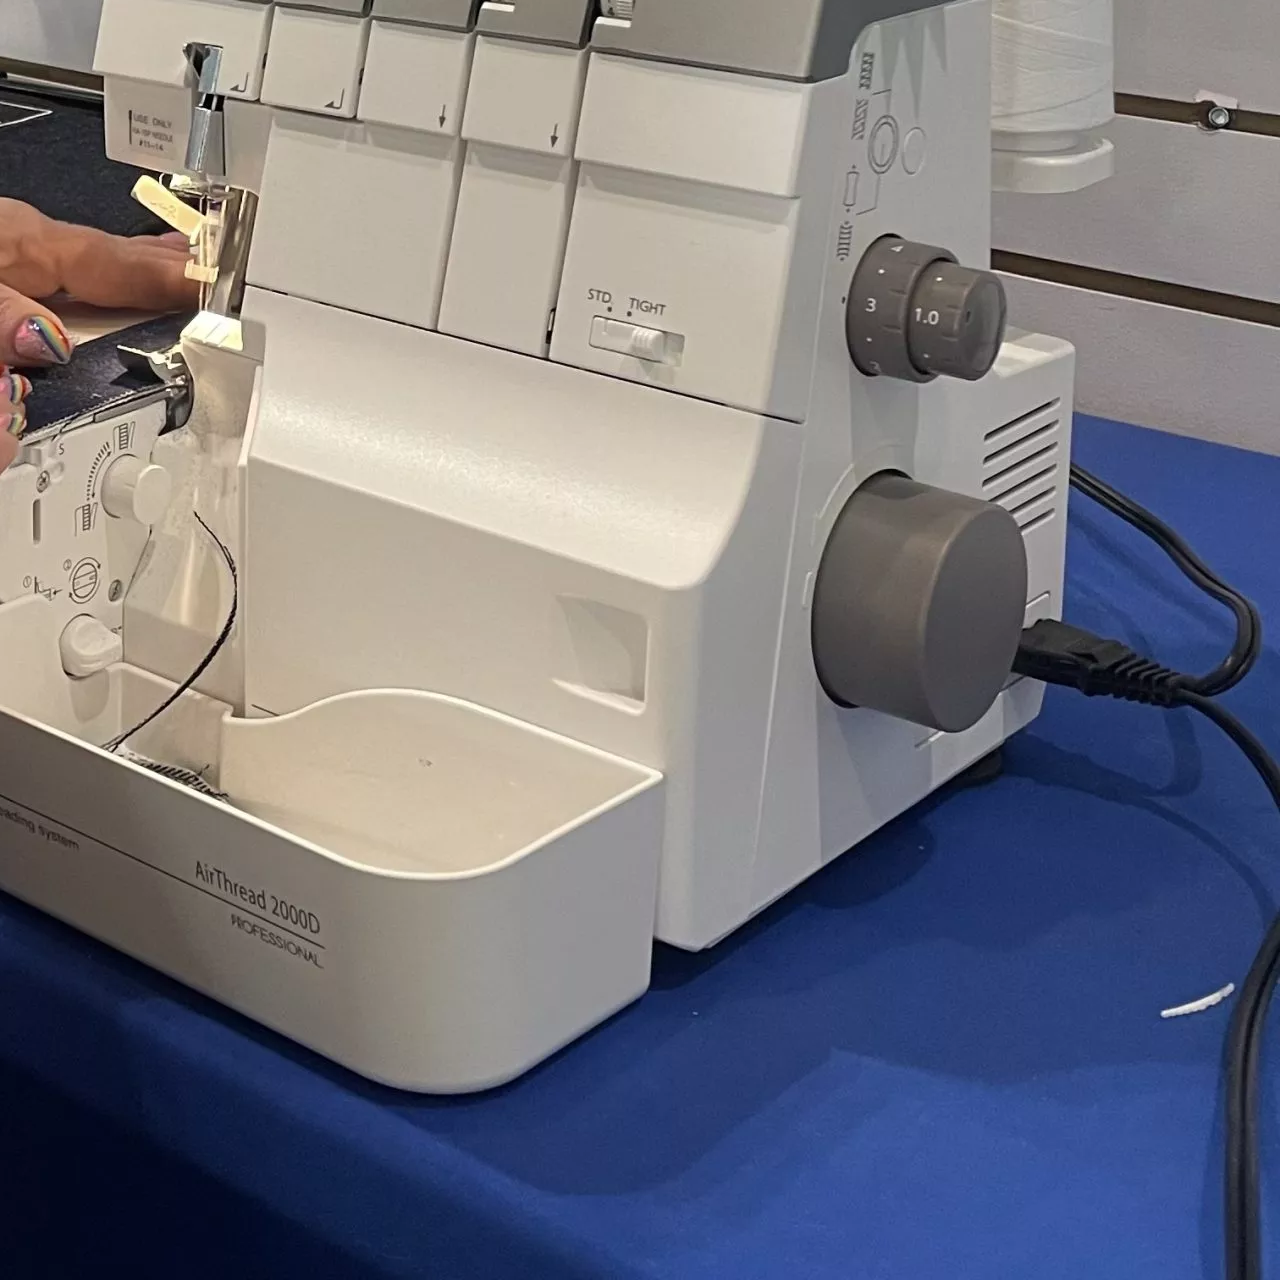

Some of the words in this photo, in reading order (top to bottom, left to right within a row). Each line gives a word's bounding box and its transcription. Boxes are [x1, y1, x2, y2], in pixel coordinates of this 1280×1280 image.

[629, 297, 667, 316] TIGHT
[865, 297, 877, 313] 3
[914, 307, 940, 326] 1.0
[38, 823, 81, 851] system
[195, 860, 268, 912] AirThread
[271, 895, 321, 935] 2000D
[230, 913, 324, 970] PROFESSIONAL
